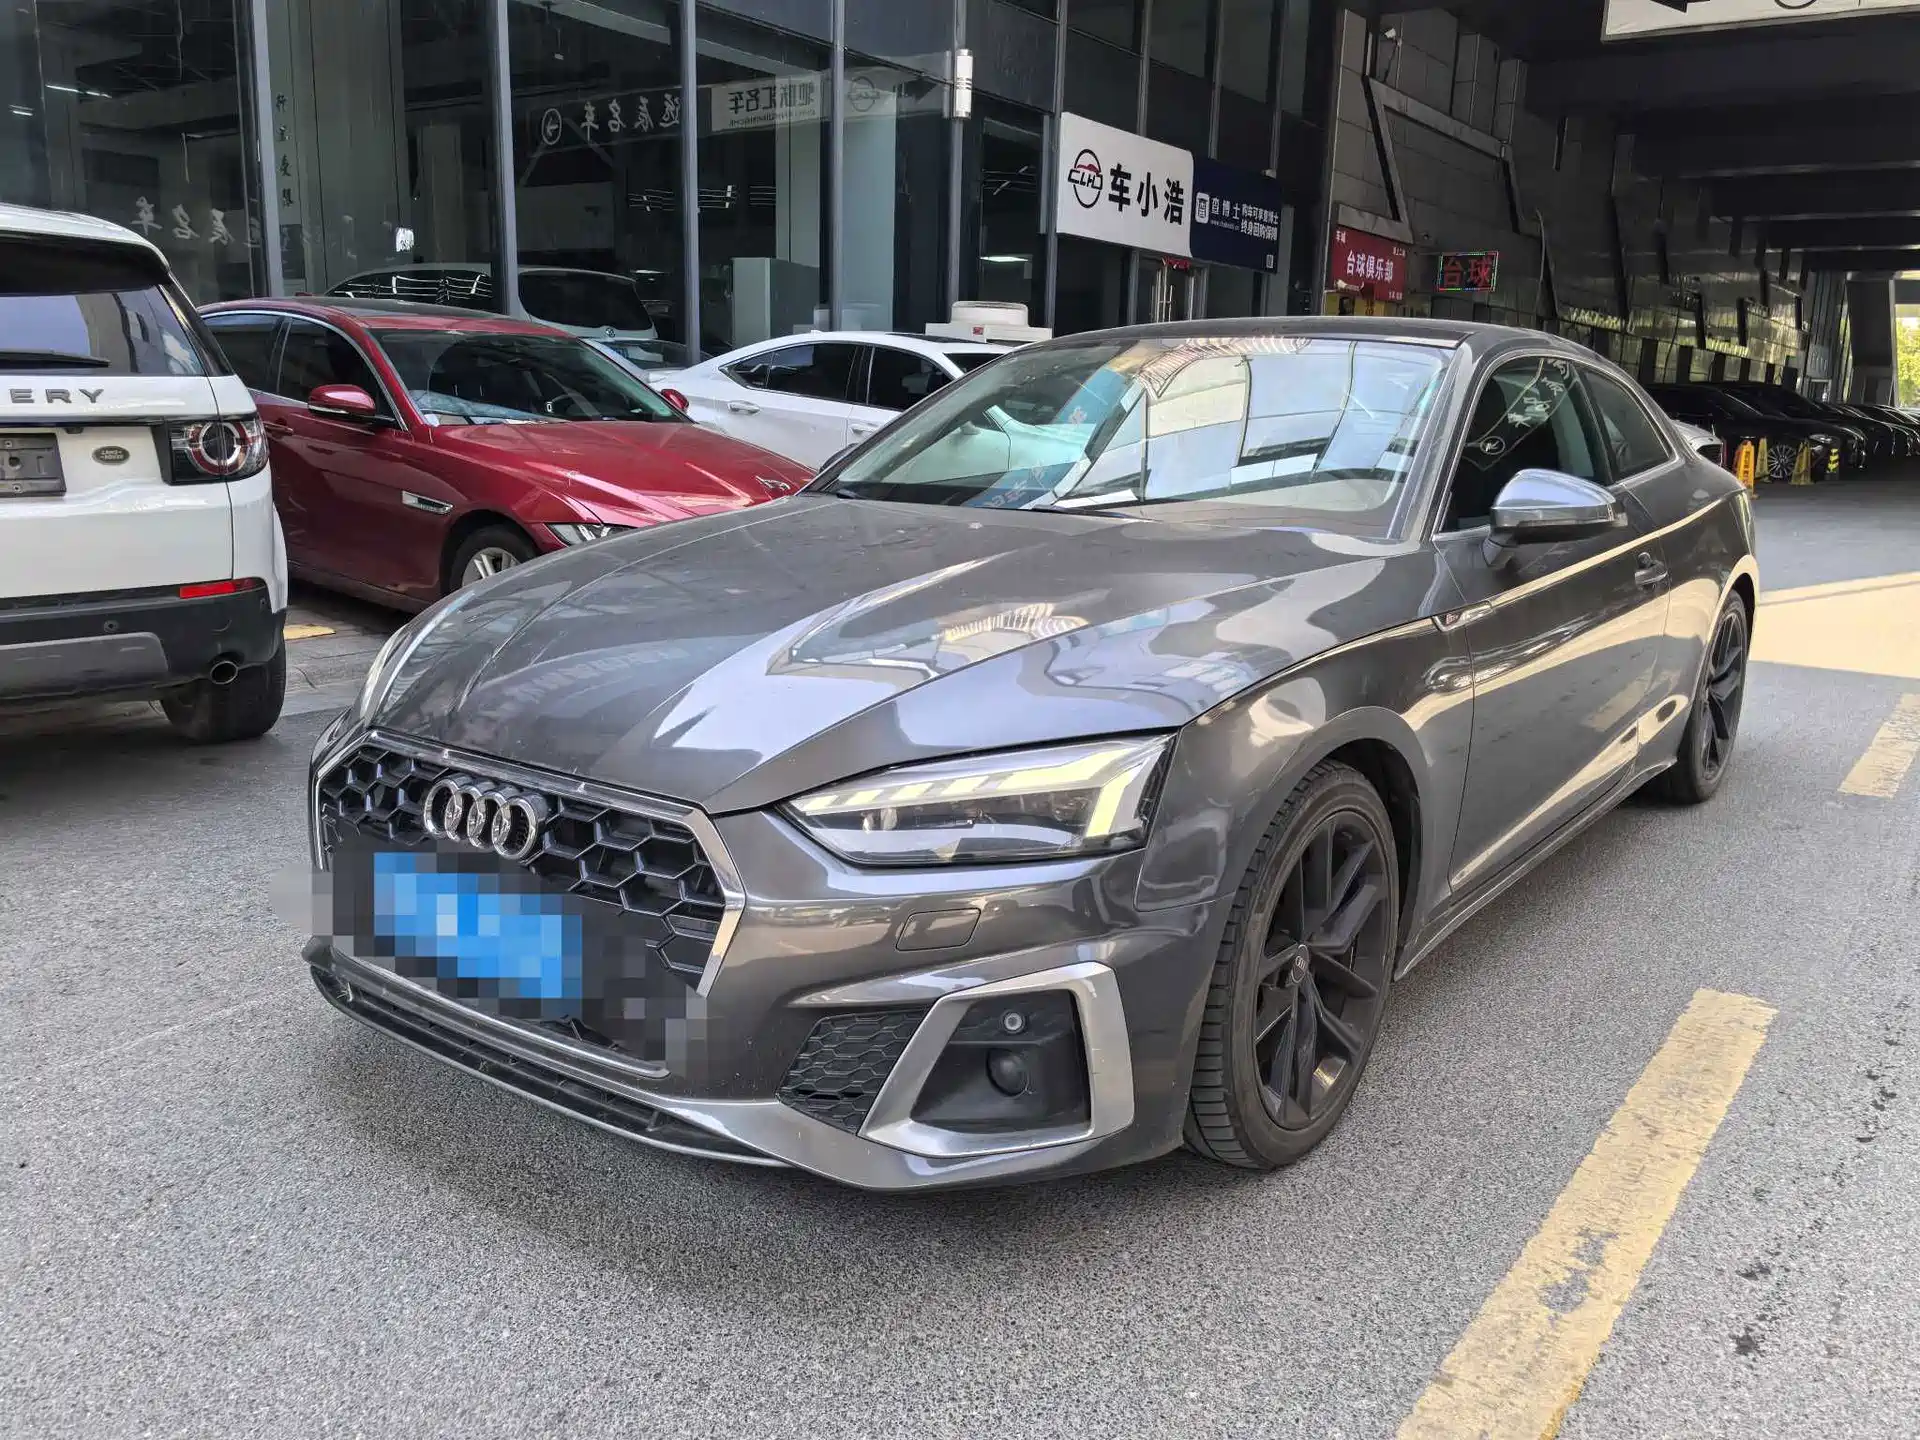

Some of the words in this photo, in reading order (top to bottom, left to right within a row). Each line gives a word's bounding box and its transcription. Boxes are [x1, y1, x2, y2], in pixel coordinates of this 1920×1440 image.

[1108, 163, 1185, 226] 车小浩
[1346, 250, 1394, 284] 台球俱乐部
[1443, 257, 1492, 287] 台球
[9, 388, 104, 404] ERY
